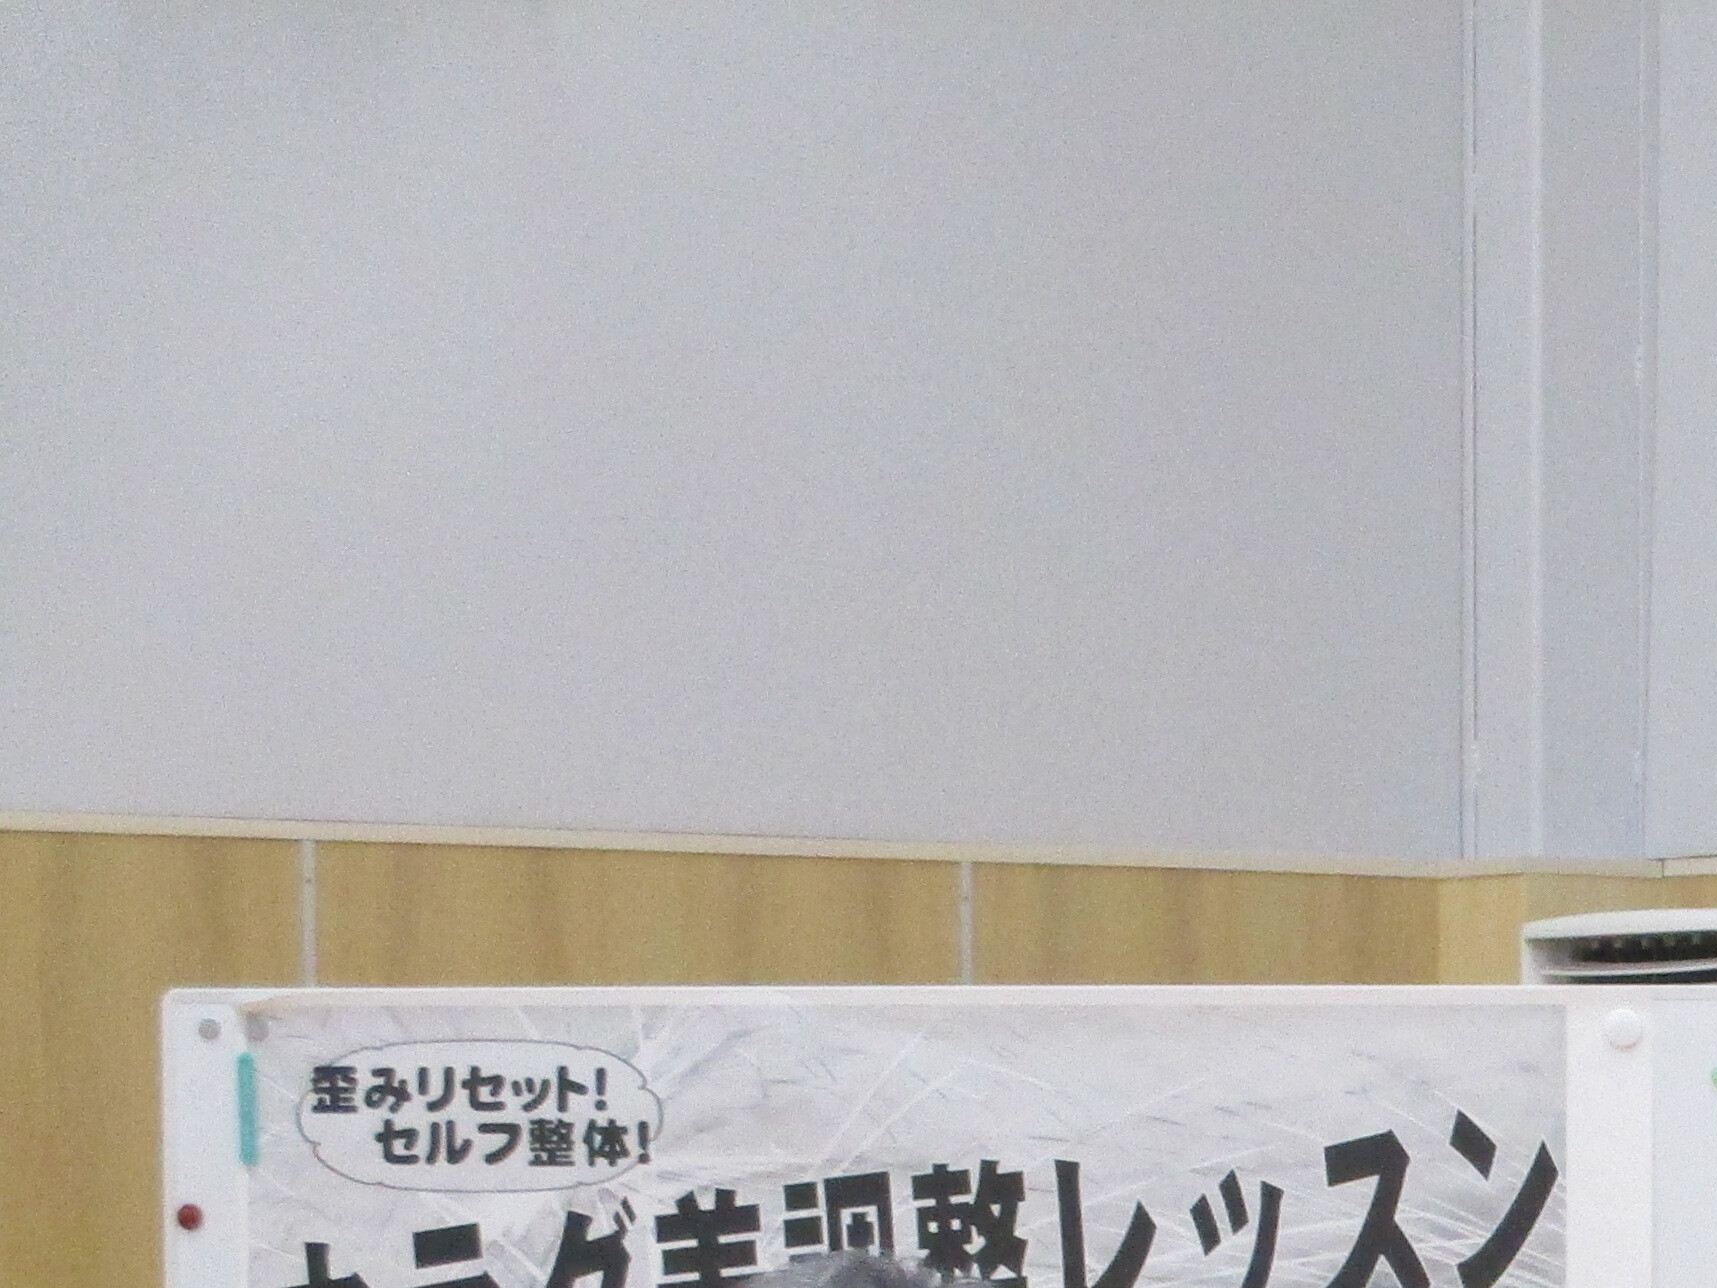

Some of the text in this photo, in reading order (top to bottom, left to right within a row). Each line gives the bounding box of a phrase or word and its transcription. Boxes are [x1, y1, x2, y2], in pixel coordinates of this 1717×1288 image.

[310, 1064, 607, 1114] 歪みリセット!
[374, 1118, 650, 1167] セルフ整体!
